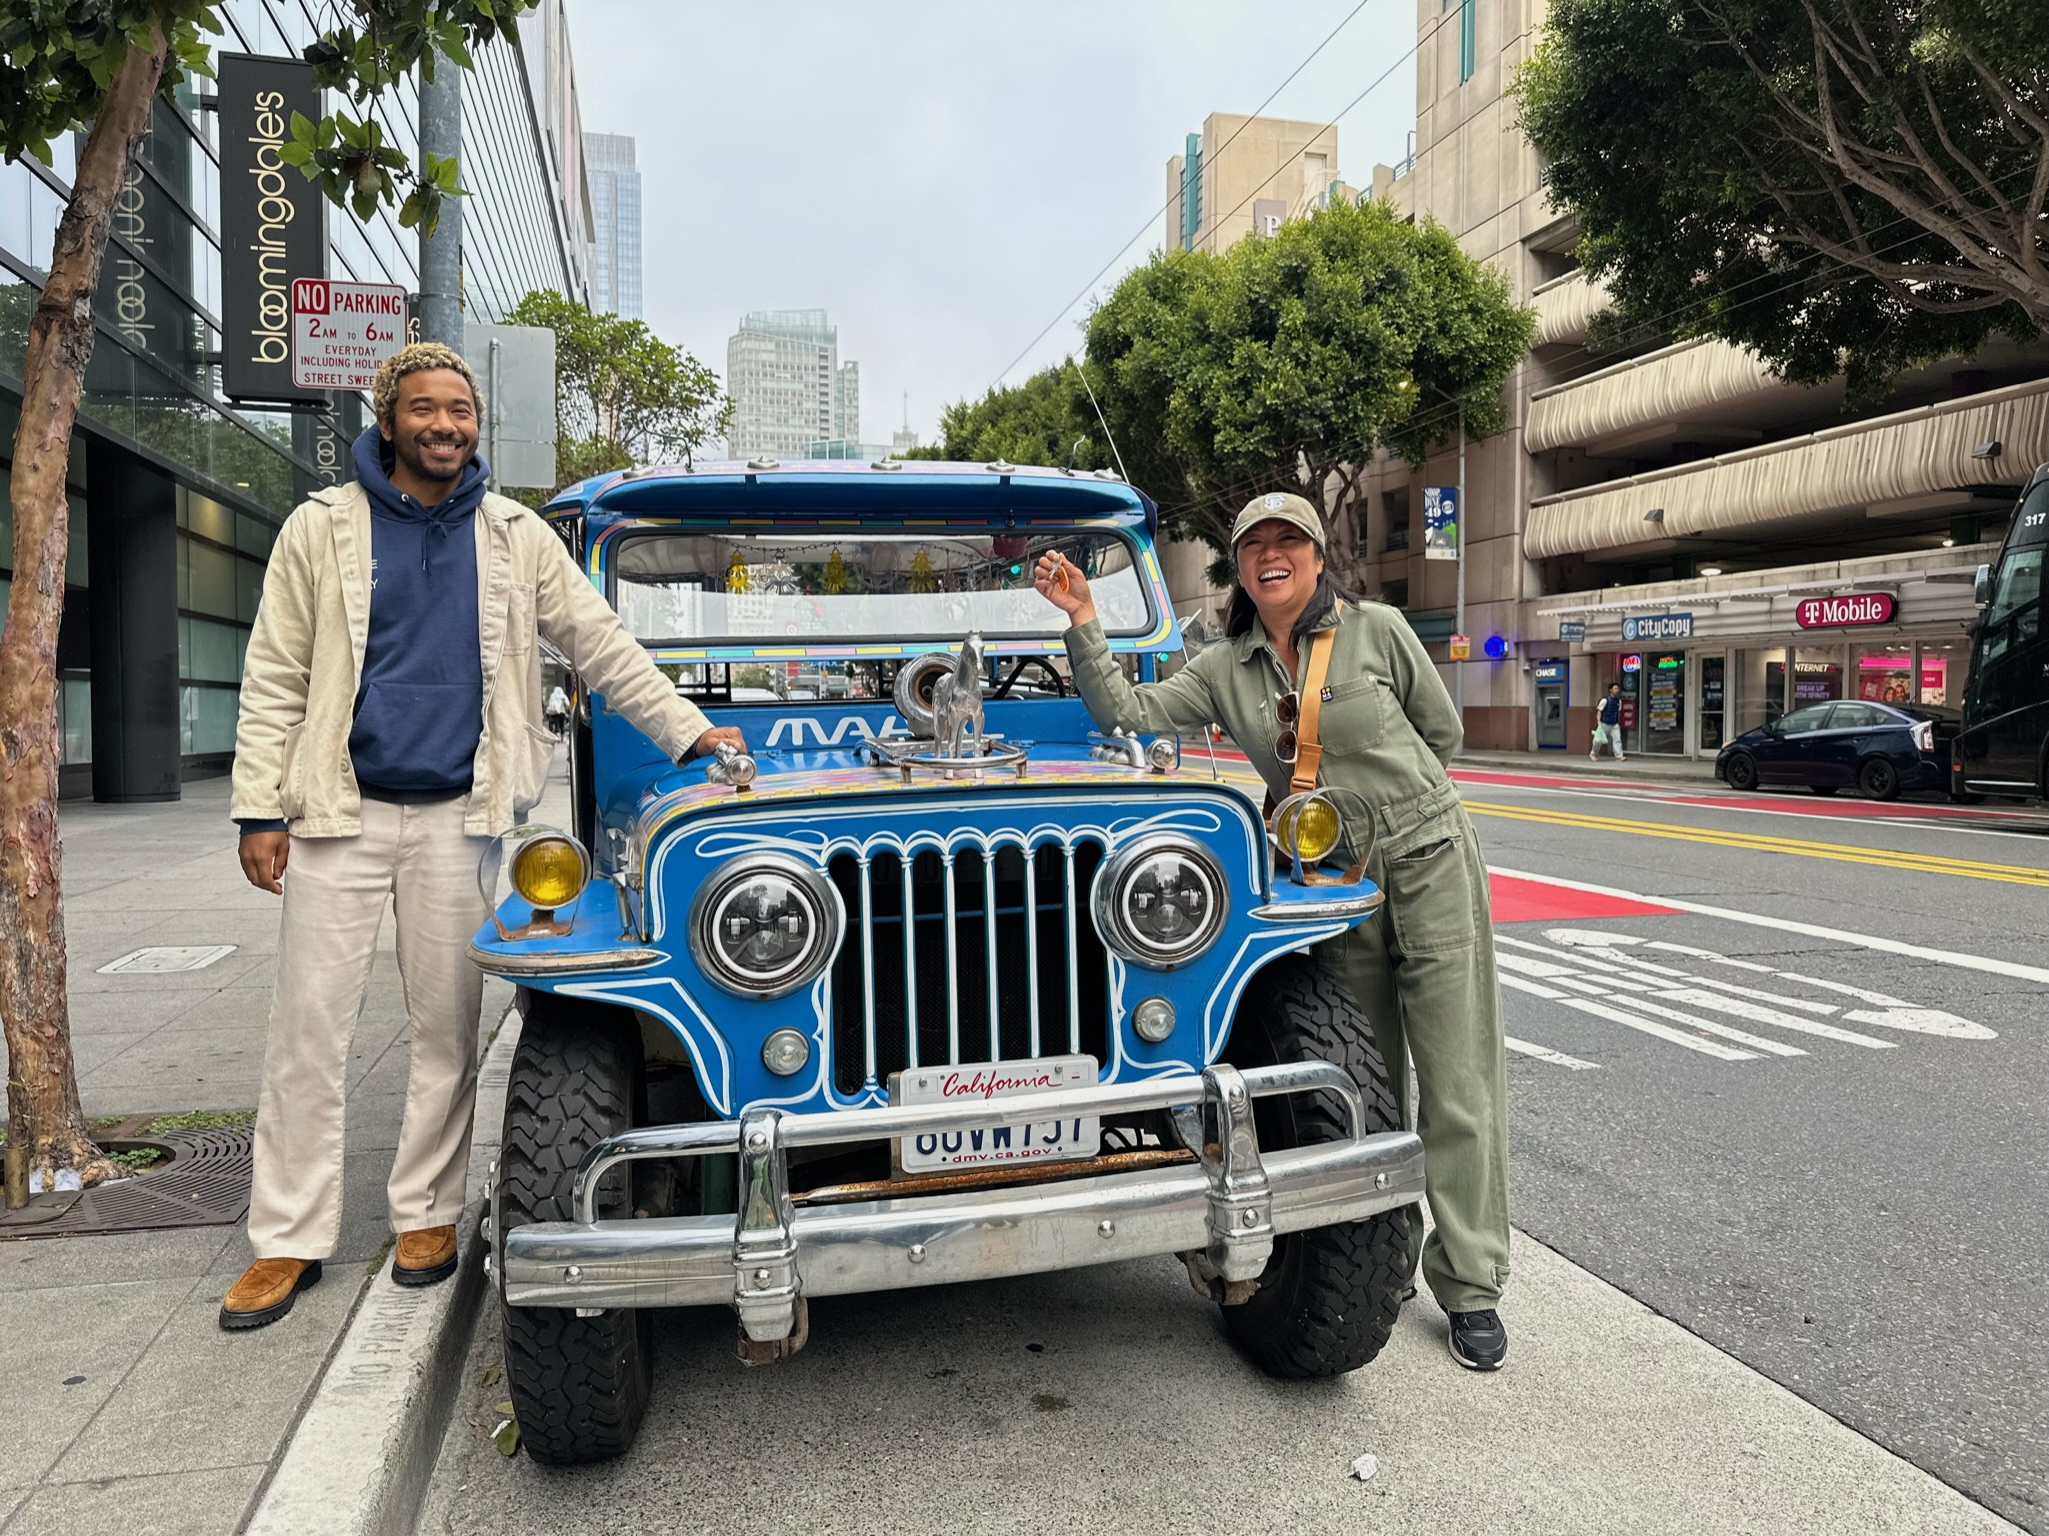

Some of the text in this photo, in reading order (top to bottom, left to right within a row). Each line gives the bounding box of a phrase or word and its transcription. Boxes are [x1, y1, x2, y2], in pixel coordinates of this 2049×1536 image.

[249, 91, 295, 364] bloomingdale's
[297, 283, 401, 316] NO PARKING
[347, 332, 357, 341] TO
[325, 344, 377, 357] EVERYDAY
[300, 356, 383, 370] INCLUDING HOLID
[304, 372, 376, 386] STREET SWEE
[2024, 512, 2047, 527] 317
[1821, 597, 1882, 623] Mobile
[1637, 618, 1691, 639] CityCopy
[1535, 668, 1557, 677] CHASE
[1794, 663, 1830, 673] NTERNET
[942, 1070, 1063, 1099] California
[952, 1147, 1052, 1163] dmv.ca.gov
